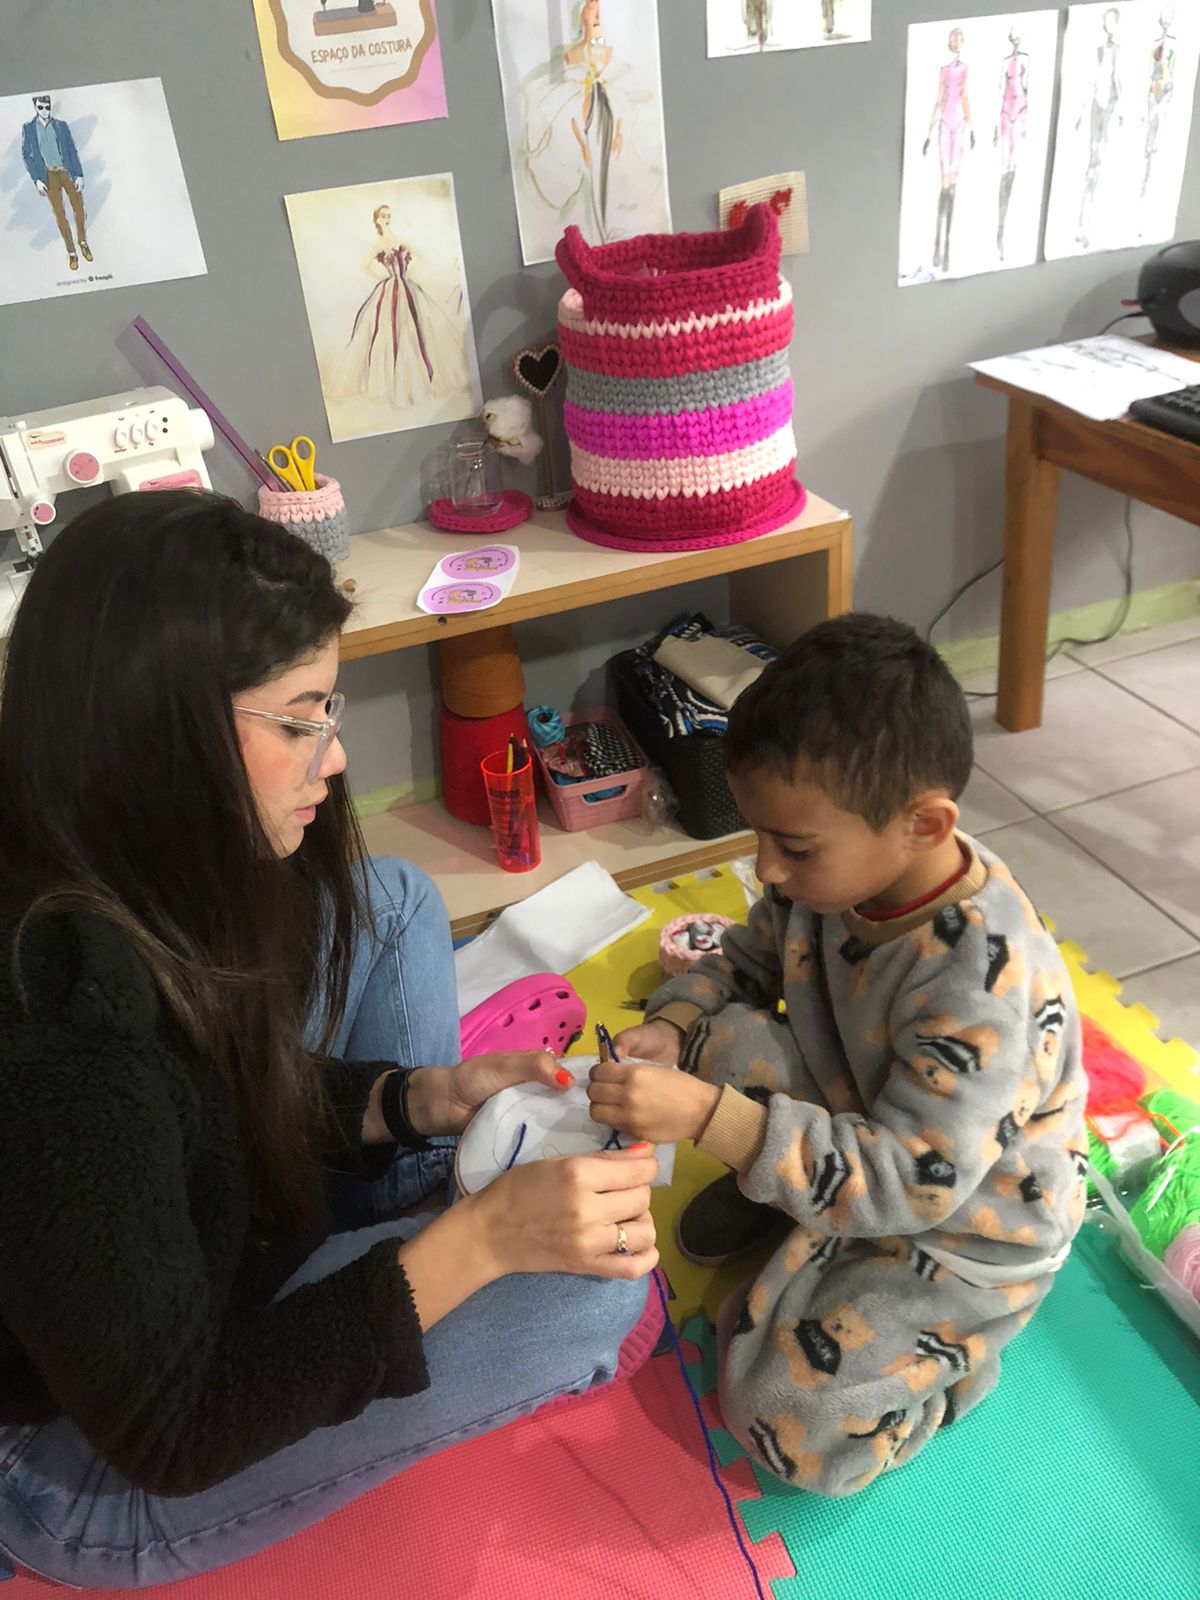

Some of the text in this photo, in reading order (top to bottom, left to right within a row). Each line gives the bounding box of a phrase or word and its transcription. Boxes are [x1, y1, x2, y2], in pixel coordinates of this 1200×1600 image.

[311, 38, 413, 64] ESPAÇO DA COSTURA
